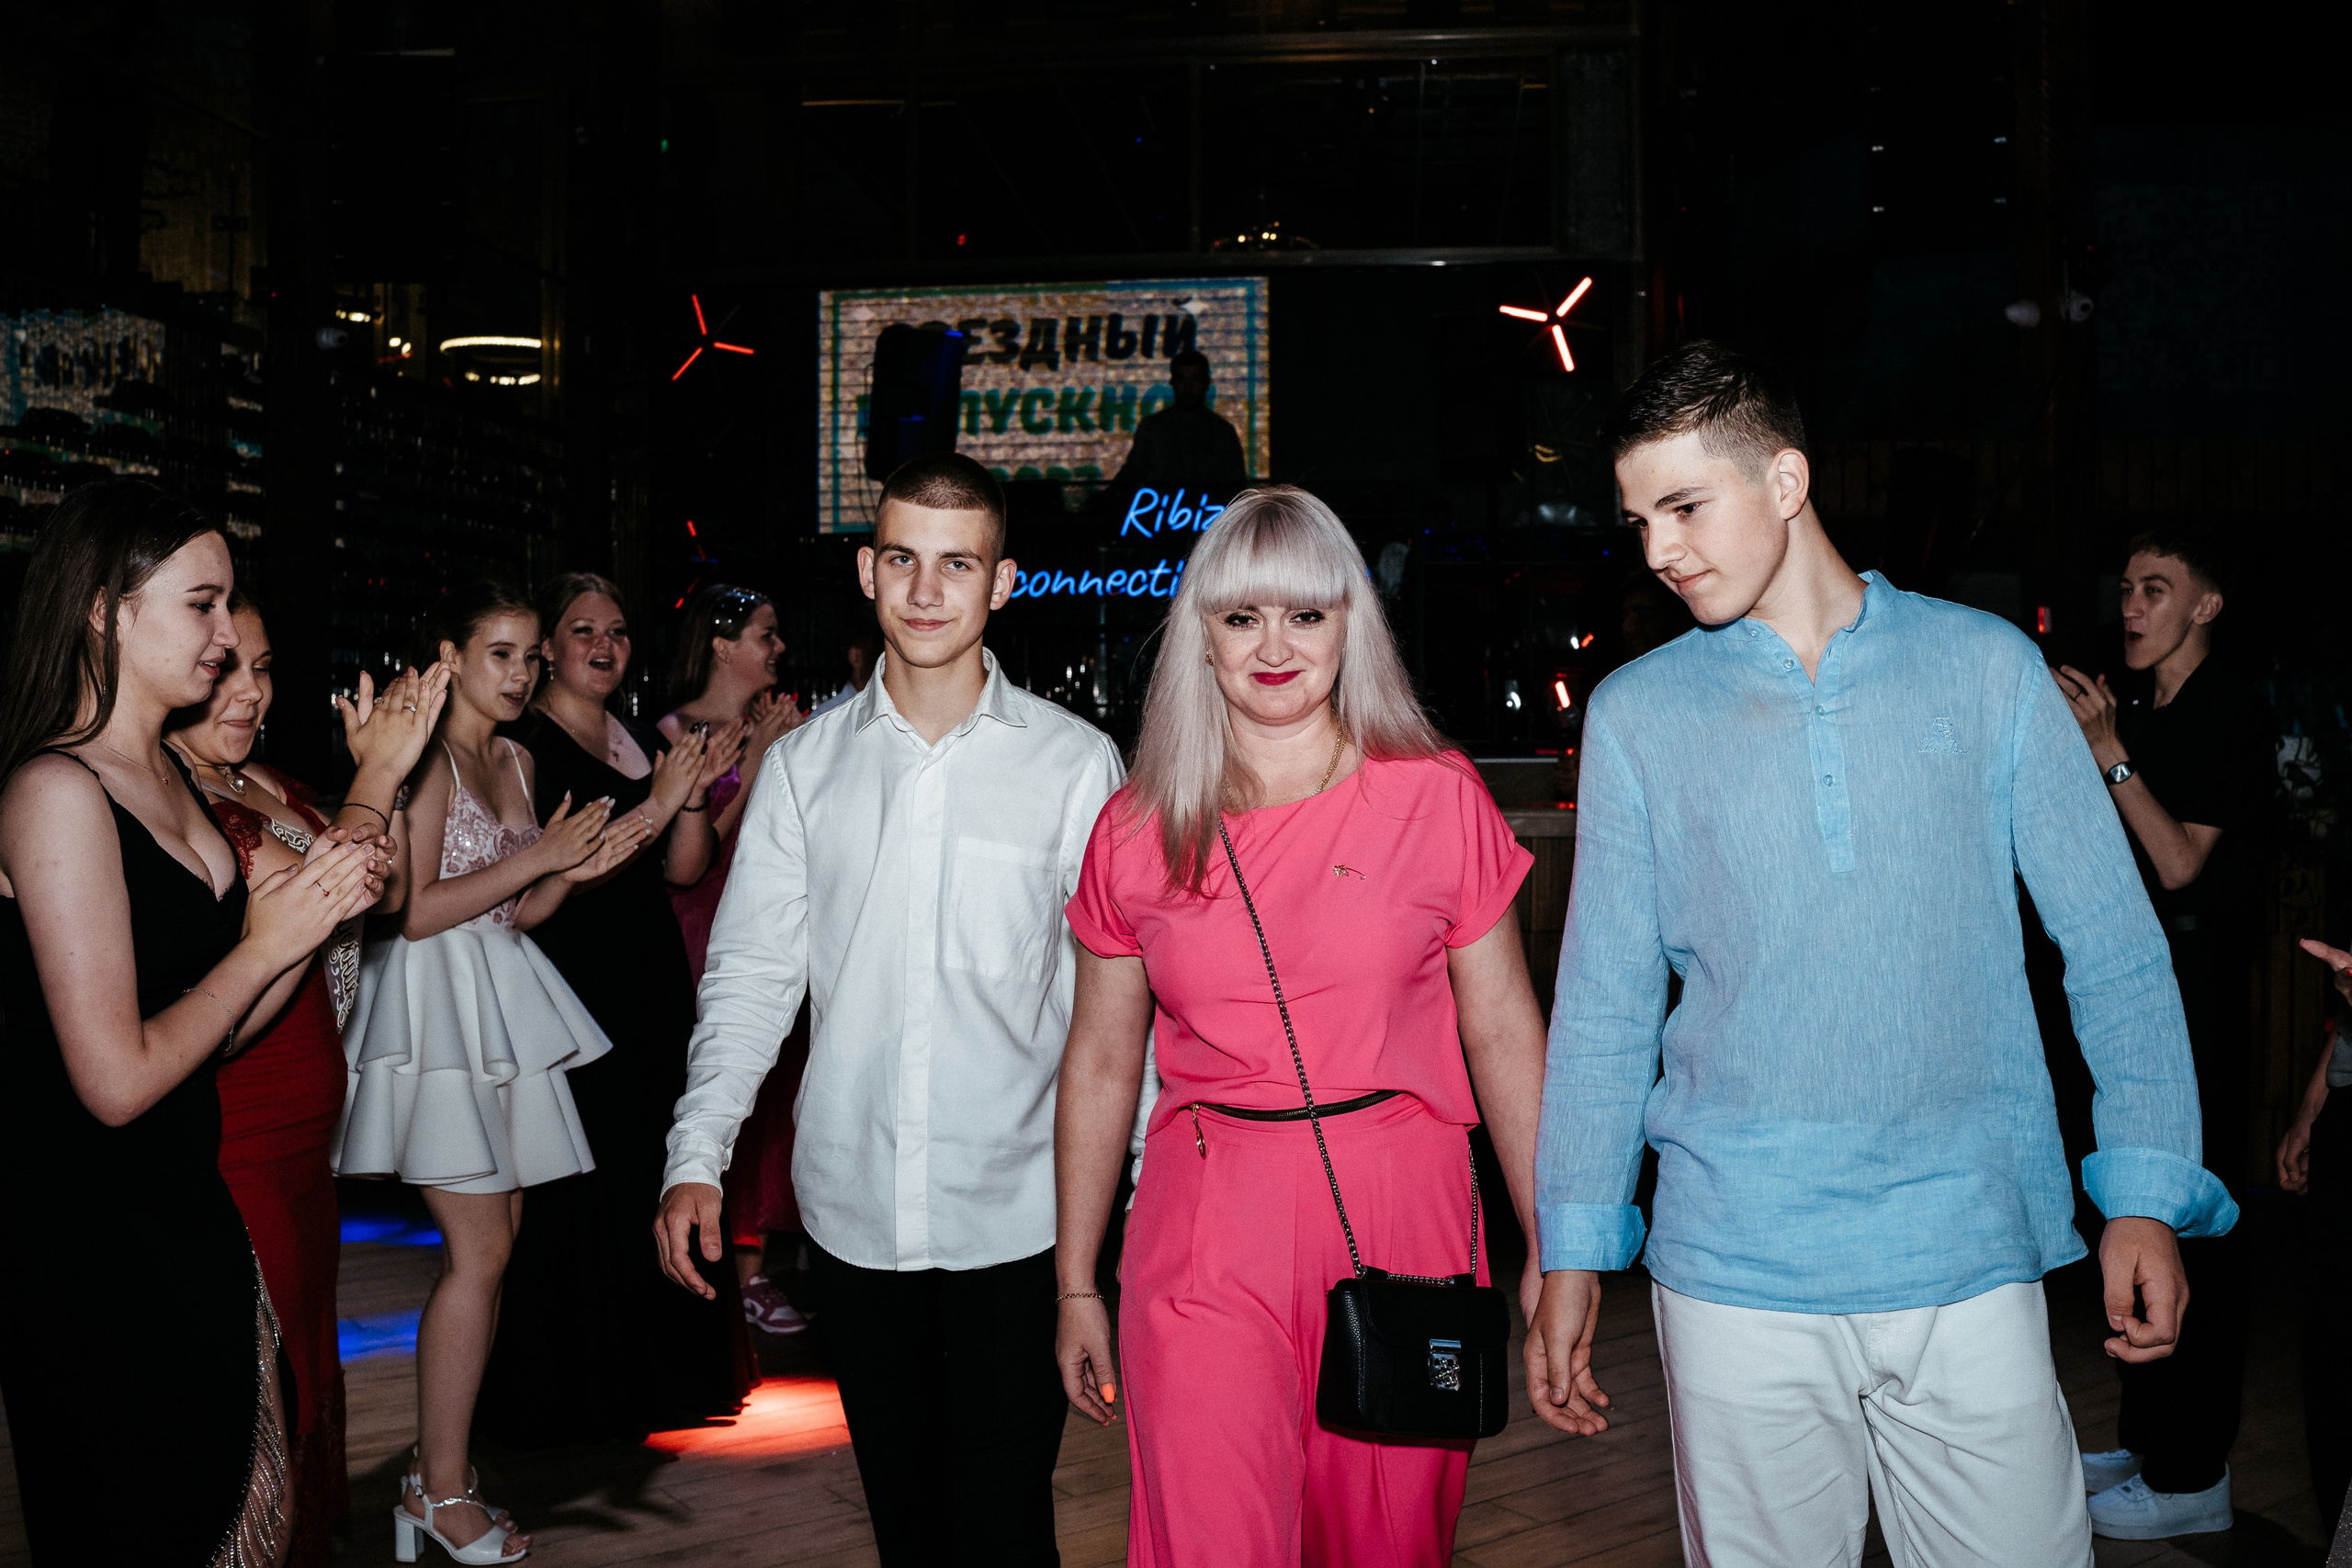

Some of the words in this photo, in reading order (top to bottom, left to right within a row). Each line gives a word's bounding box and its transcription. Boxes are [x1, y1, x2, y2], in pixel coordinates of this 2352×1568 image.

[919, 297, 1197, 370] ЕЗДНЫЙ
[857, 380, 1216, 435] ПУСКНО
[1121, 488, 1226, 537] Ribiz
[1011, 558, 1184, 597] connecti
